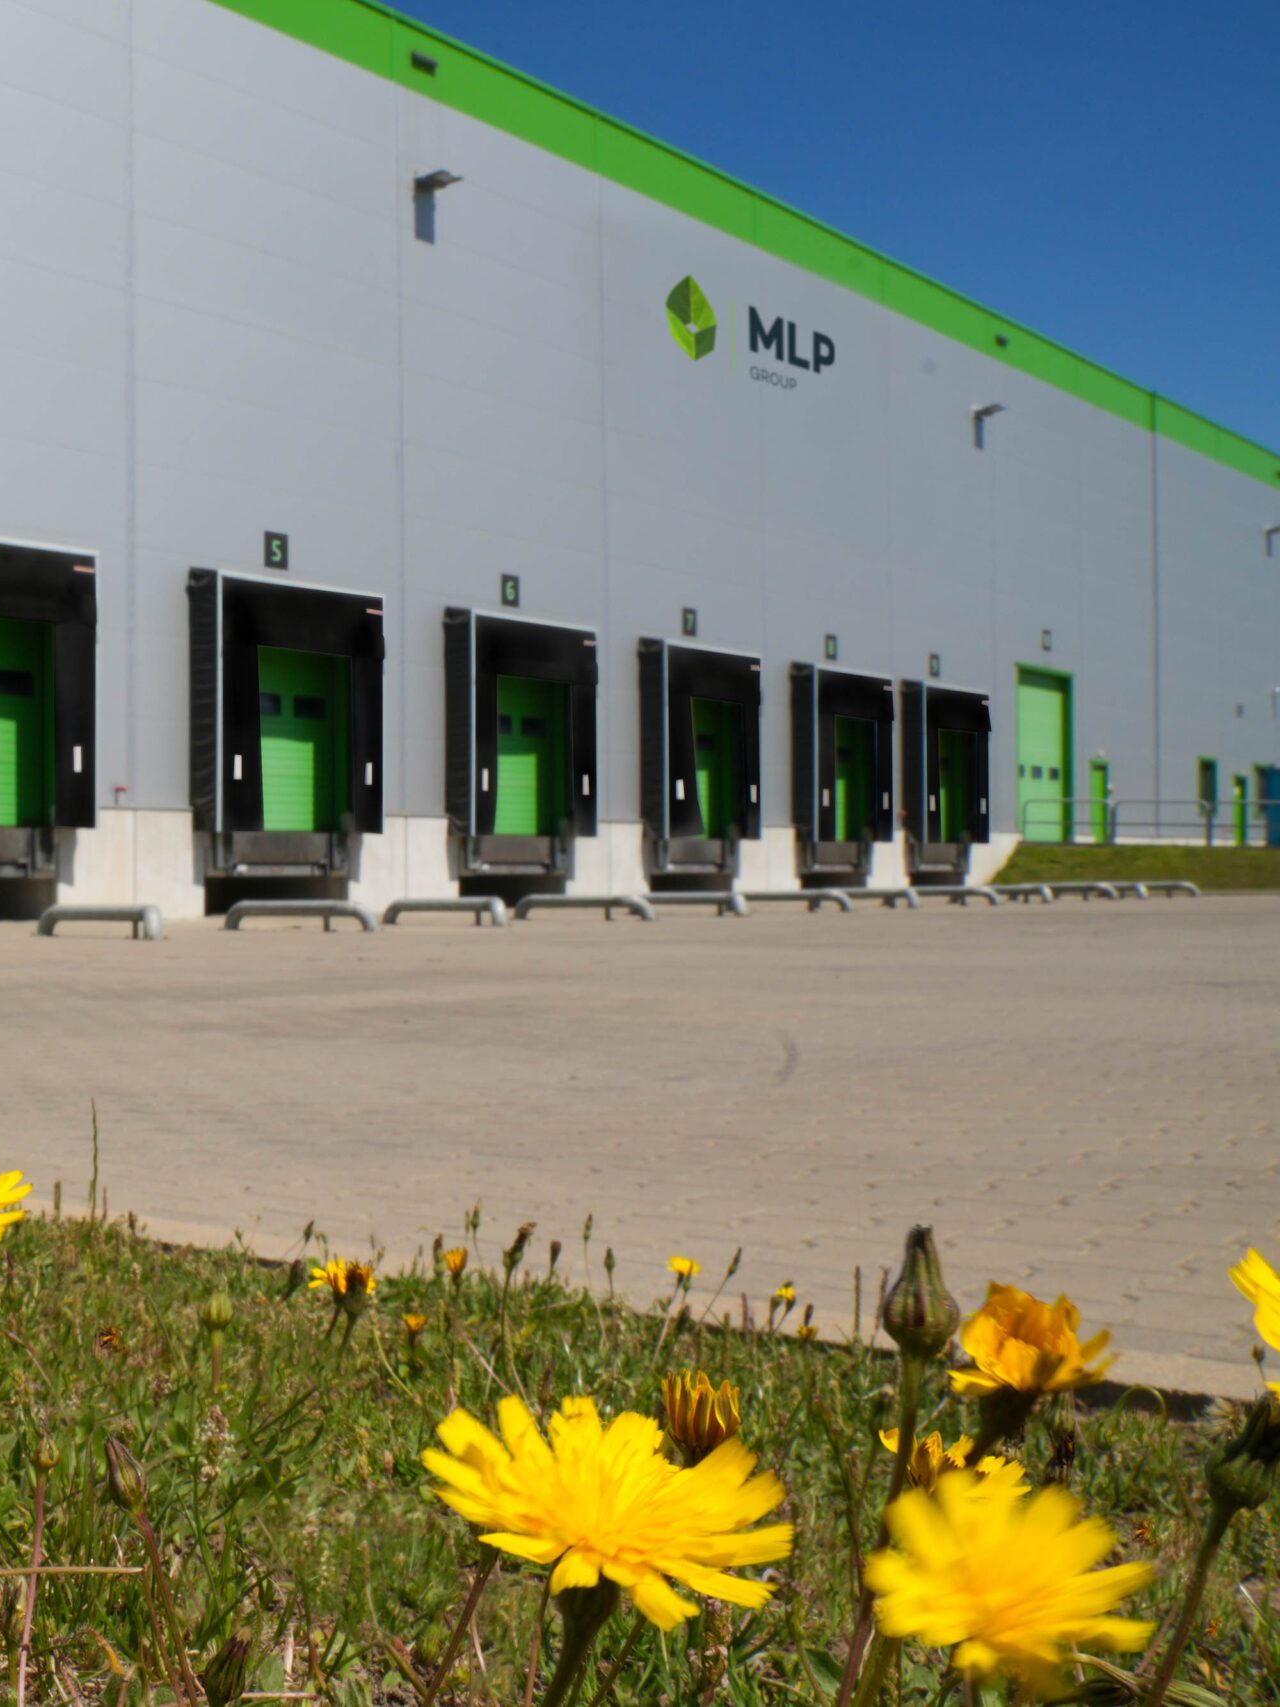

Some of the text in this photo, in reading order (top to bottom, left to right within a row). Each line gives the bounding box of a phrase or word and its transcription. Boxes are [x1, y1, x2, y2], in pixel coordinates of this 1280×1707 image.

[748, 305, 836, 374] MLP
[749, 366, 798, 390] GROUP
[271, 539, 282, 562] 5
[504, 580, 516, 601] 6
